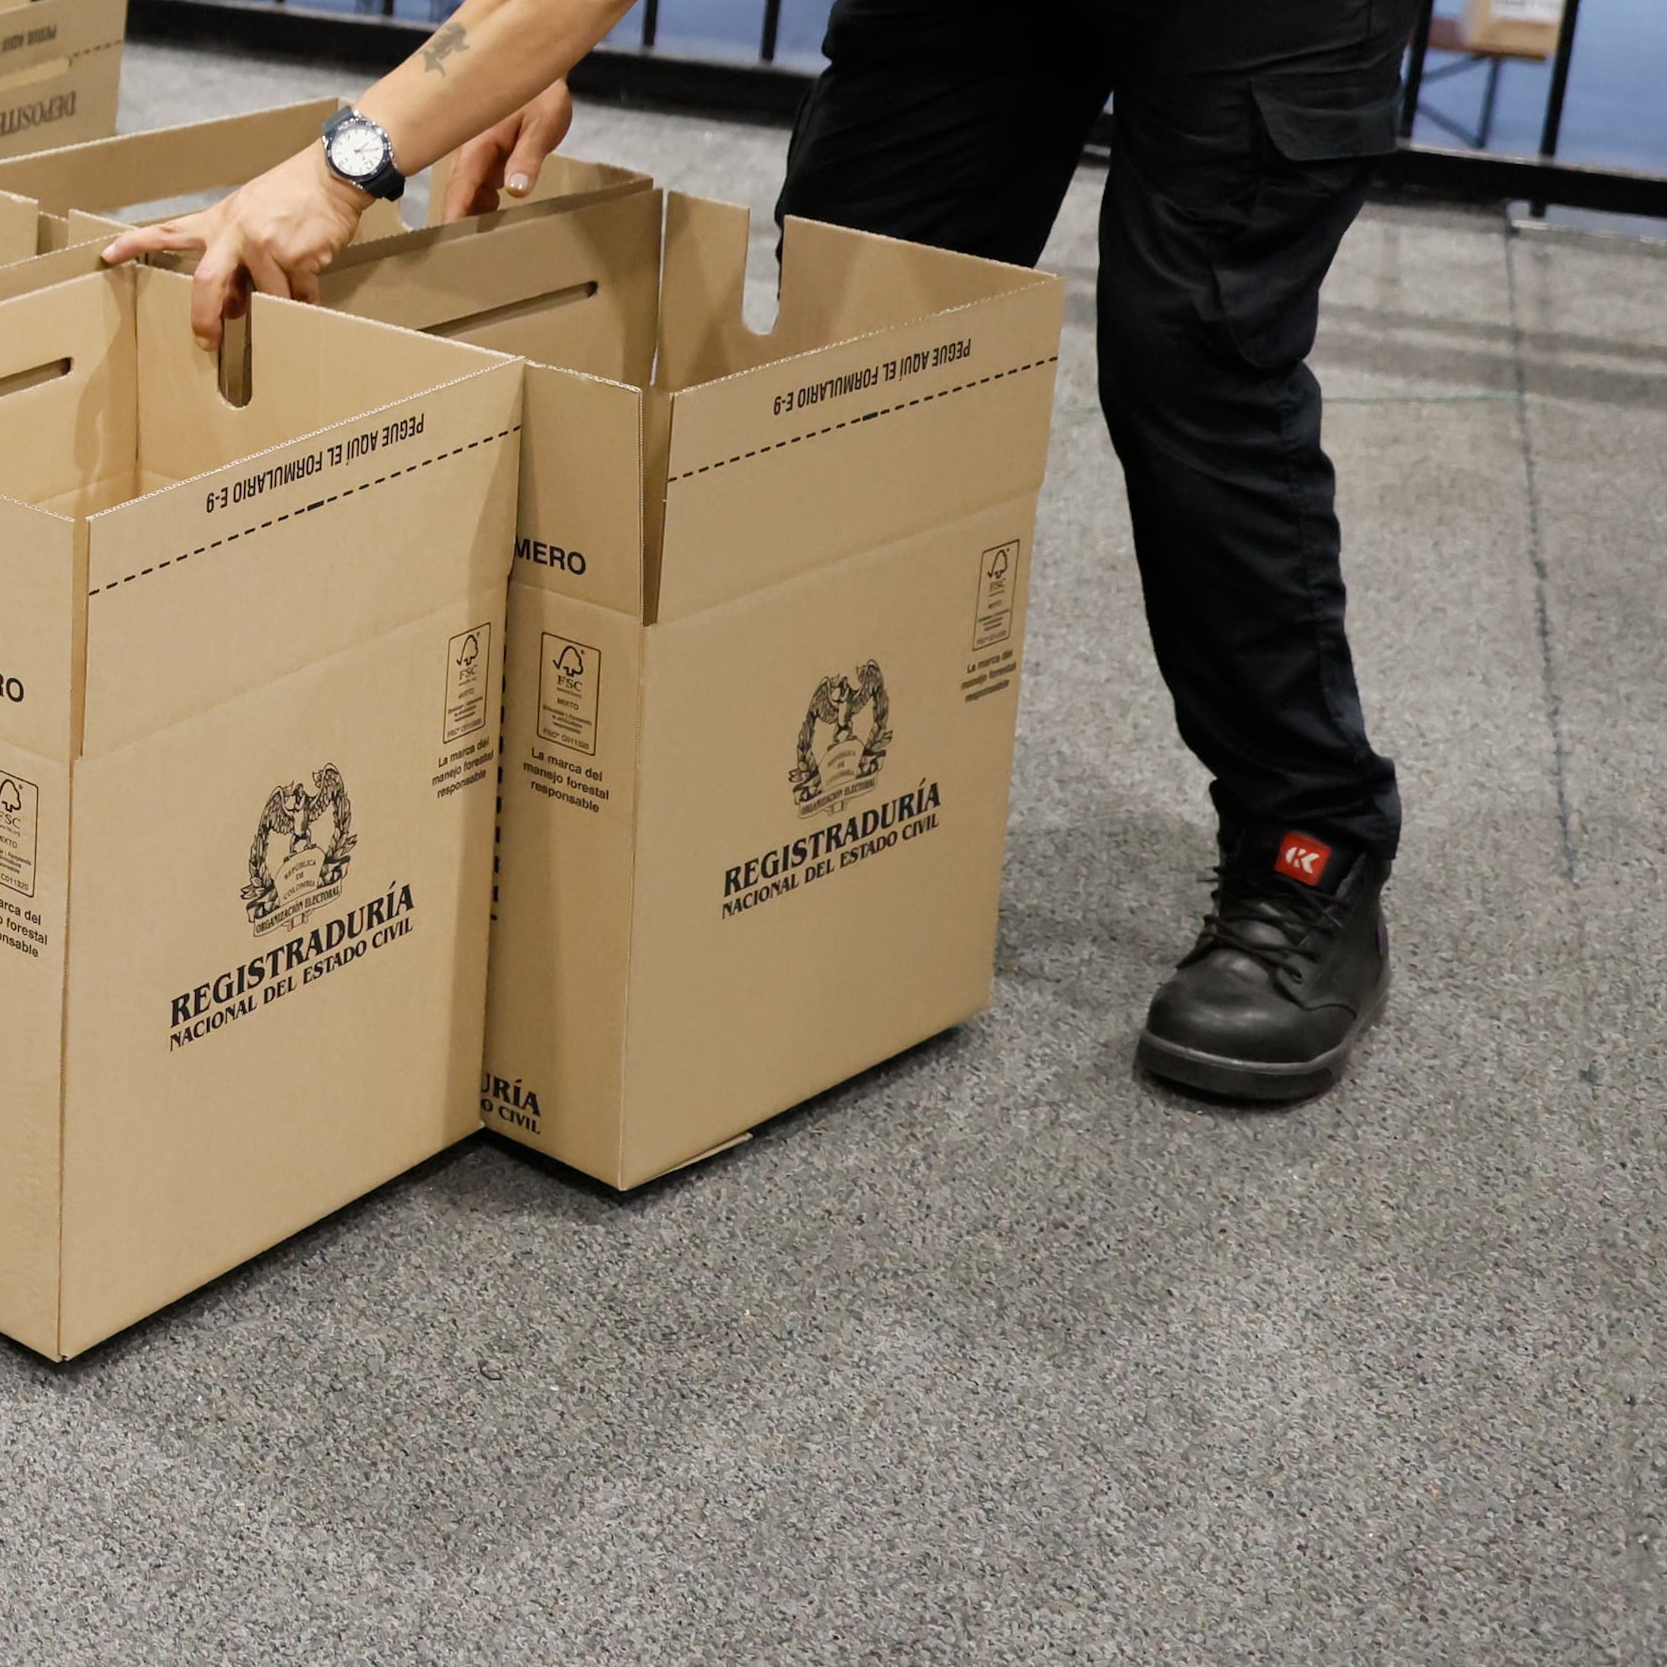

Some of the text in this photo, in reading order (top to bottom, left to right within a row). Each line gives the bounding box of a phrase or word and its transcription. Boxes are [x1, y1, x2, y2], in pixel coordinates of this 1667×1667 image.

[773, 338, 972, 416] PEGUE AQUÍ EL FORMULARIO E-9
[206, 413, 425, 514] PEGUE AQUÍ EL FORMULARIO E-9
[459, 664, 478, 681] FSC
[557, 674, 583, 692] FSC
[432, 750, 494, 786] manejo forestal
[438, 737, 490, 768] La marca del
[531, 747, 603, 782] La marca del
[437, 769, 487, 799] responsable
[523, 761, 609, 800] manejo forestal
[531, 780, 599, 813] responsable
[724, 782, 941, 895] REGISTRADURÍA
[722, 814, 939, 920] NACIONAL DEL ESTADO CIVIL
[283, 880, 315, 900] COLOMBIA
[305, 886, 339, 908] ELECTORAL
[6, 918, 48, 945] forestal
[24, 906, 41, 926] del
[170, 884, 415, 1025] REGISTRADURÍA
[169, 921, 413, 1052] NACIONAL DEL ESTADO CIVIL
[498, 1106, 541, 1134] CIVIL
